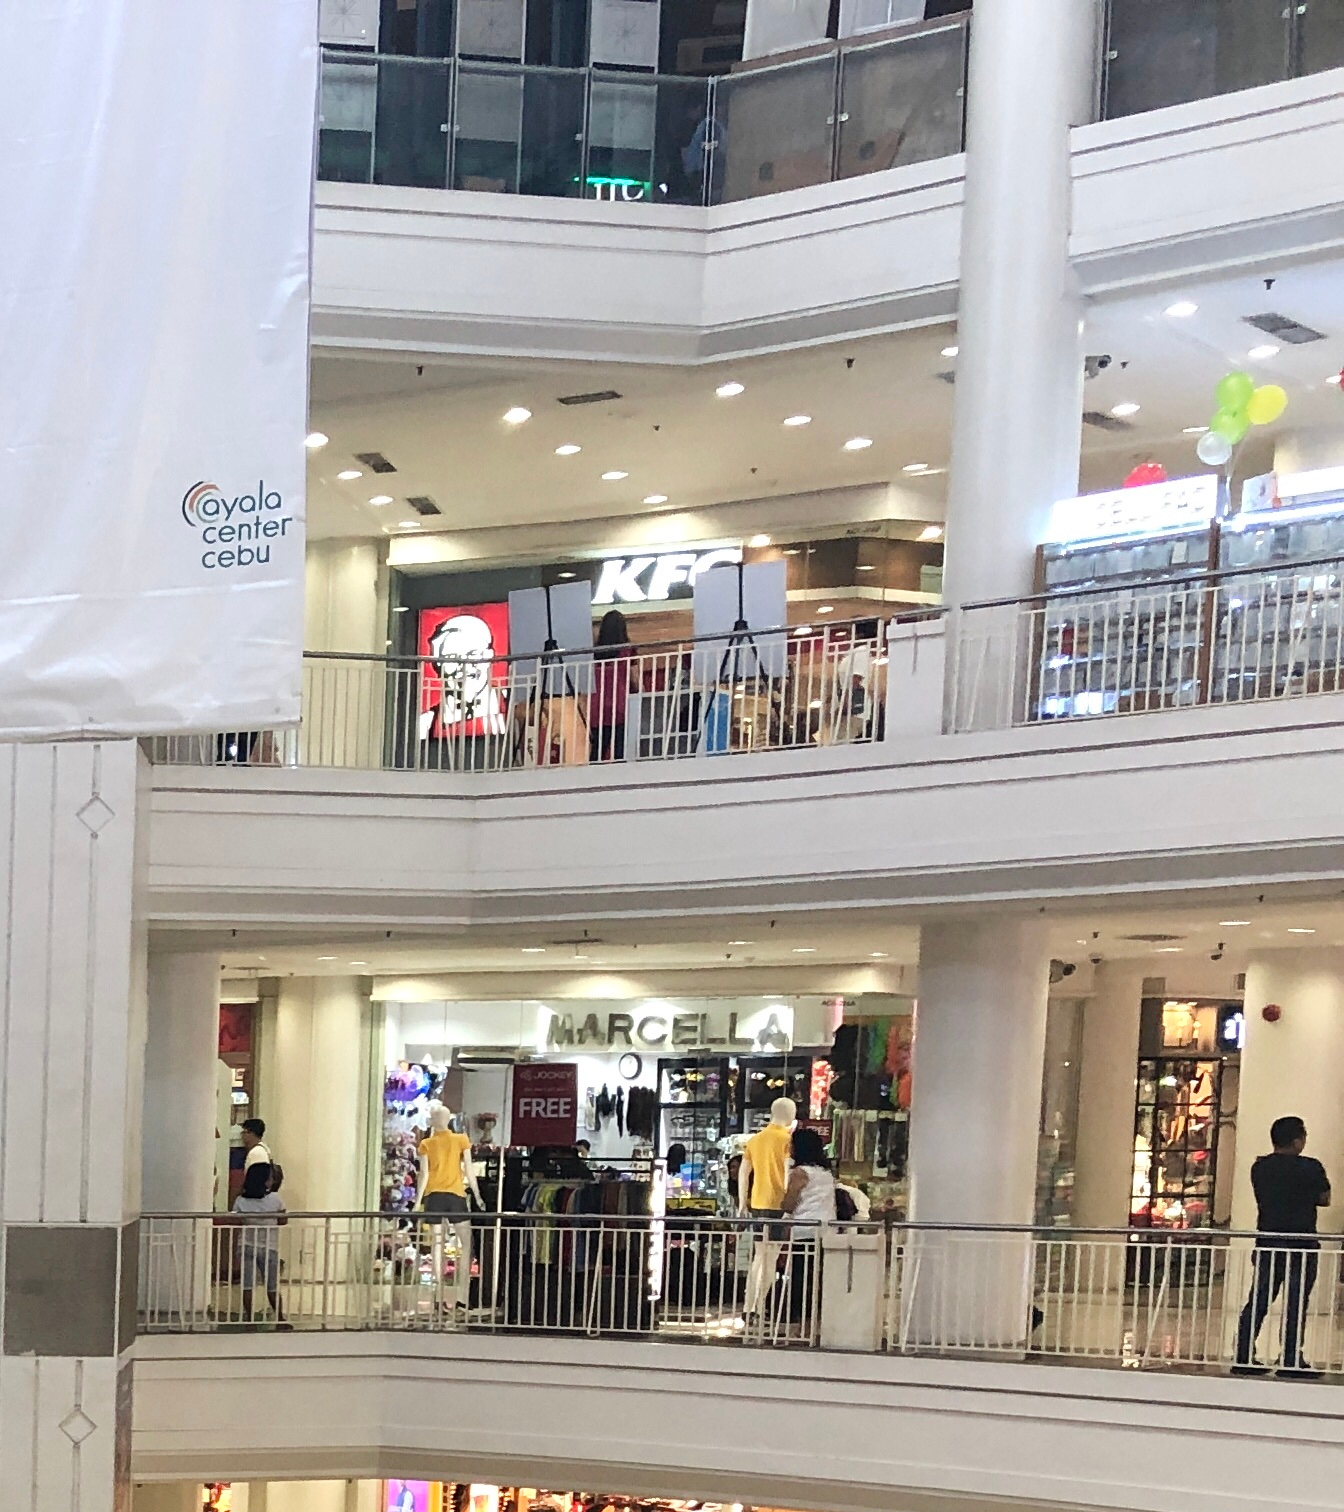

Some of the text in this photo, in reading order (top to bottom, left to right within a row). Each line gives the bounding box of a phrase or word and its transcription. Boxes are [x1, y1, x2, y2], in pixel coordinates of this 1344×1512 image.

[202, 480, 282, 520] ayala
[202, 515, 293, 544] center
[202, 541, 270, 569] cebu
[547, 1013, 790, 1049] MARCELLA
[534, 1071, 572, 1079] JOCKEY
[519, 1097, 572, 1118] FREE
